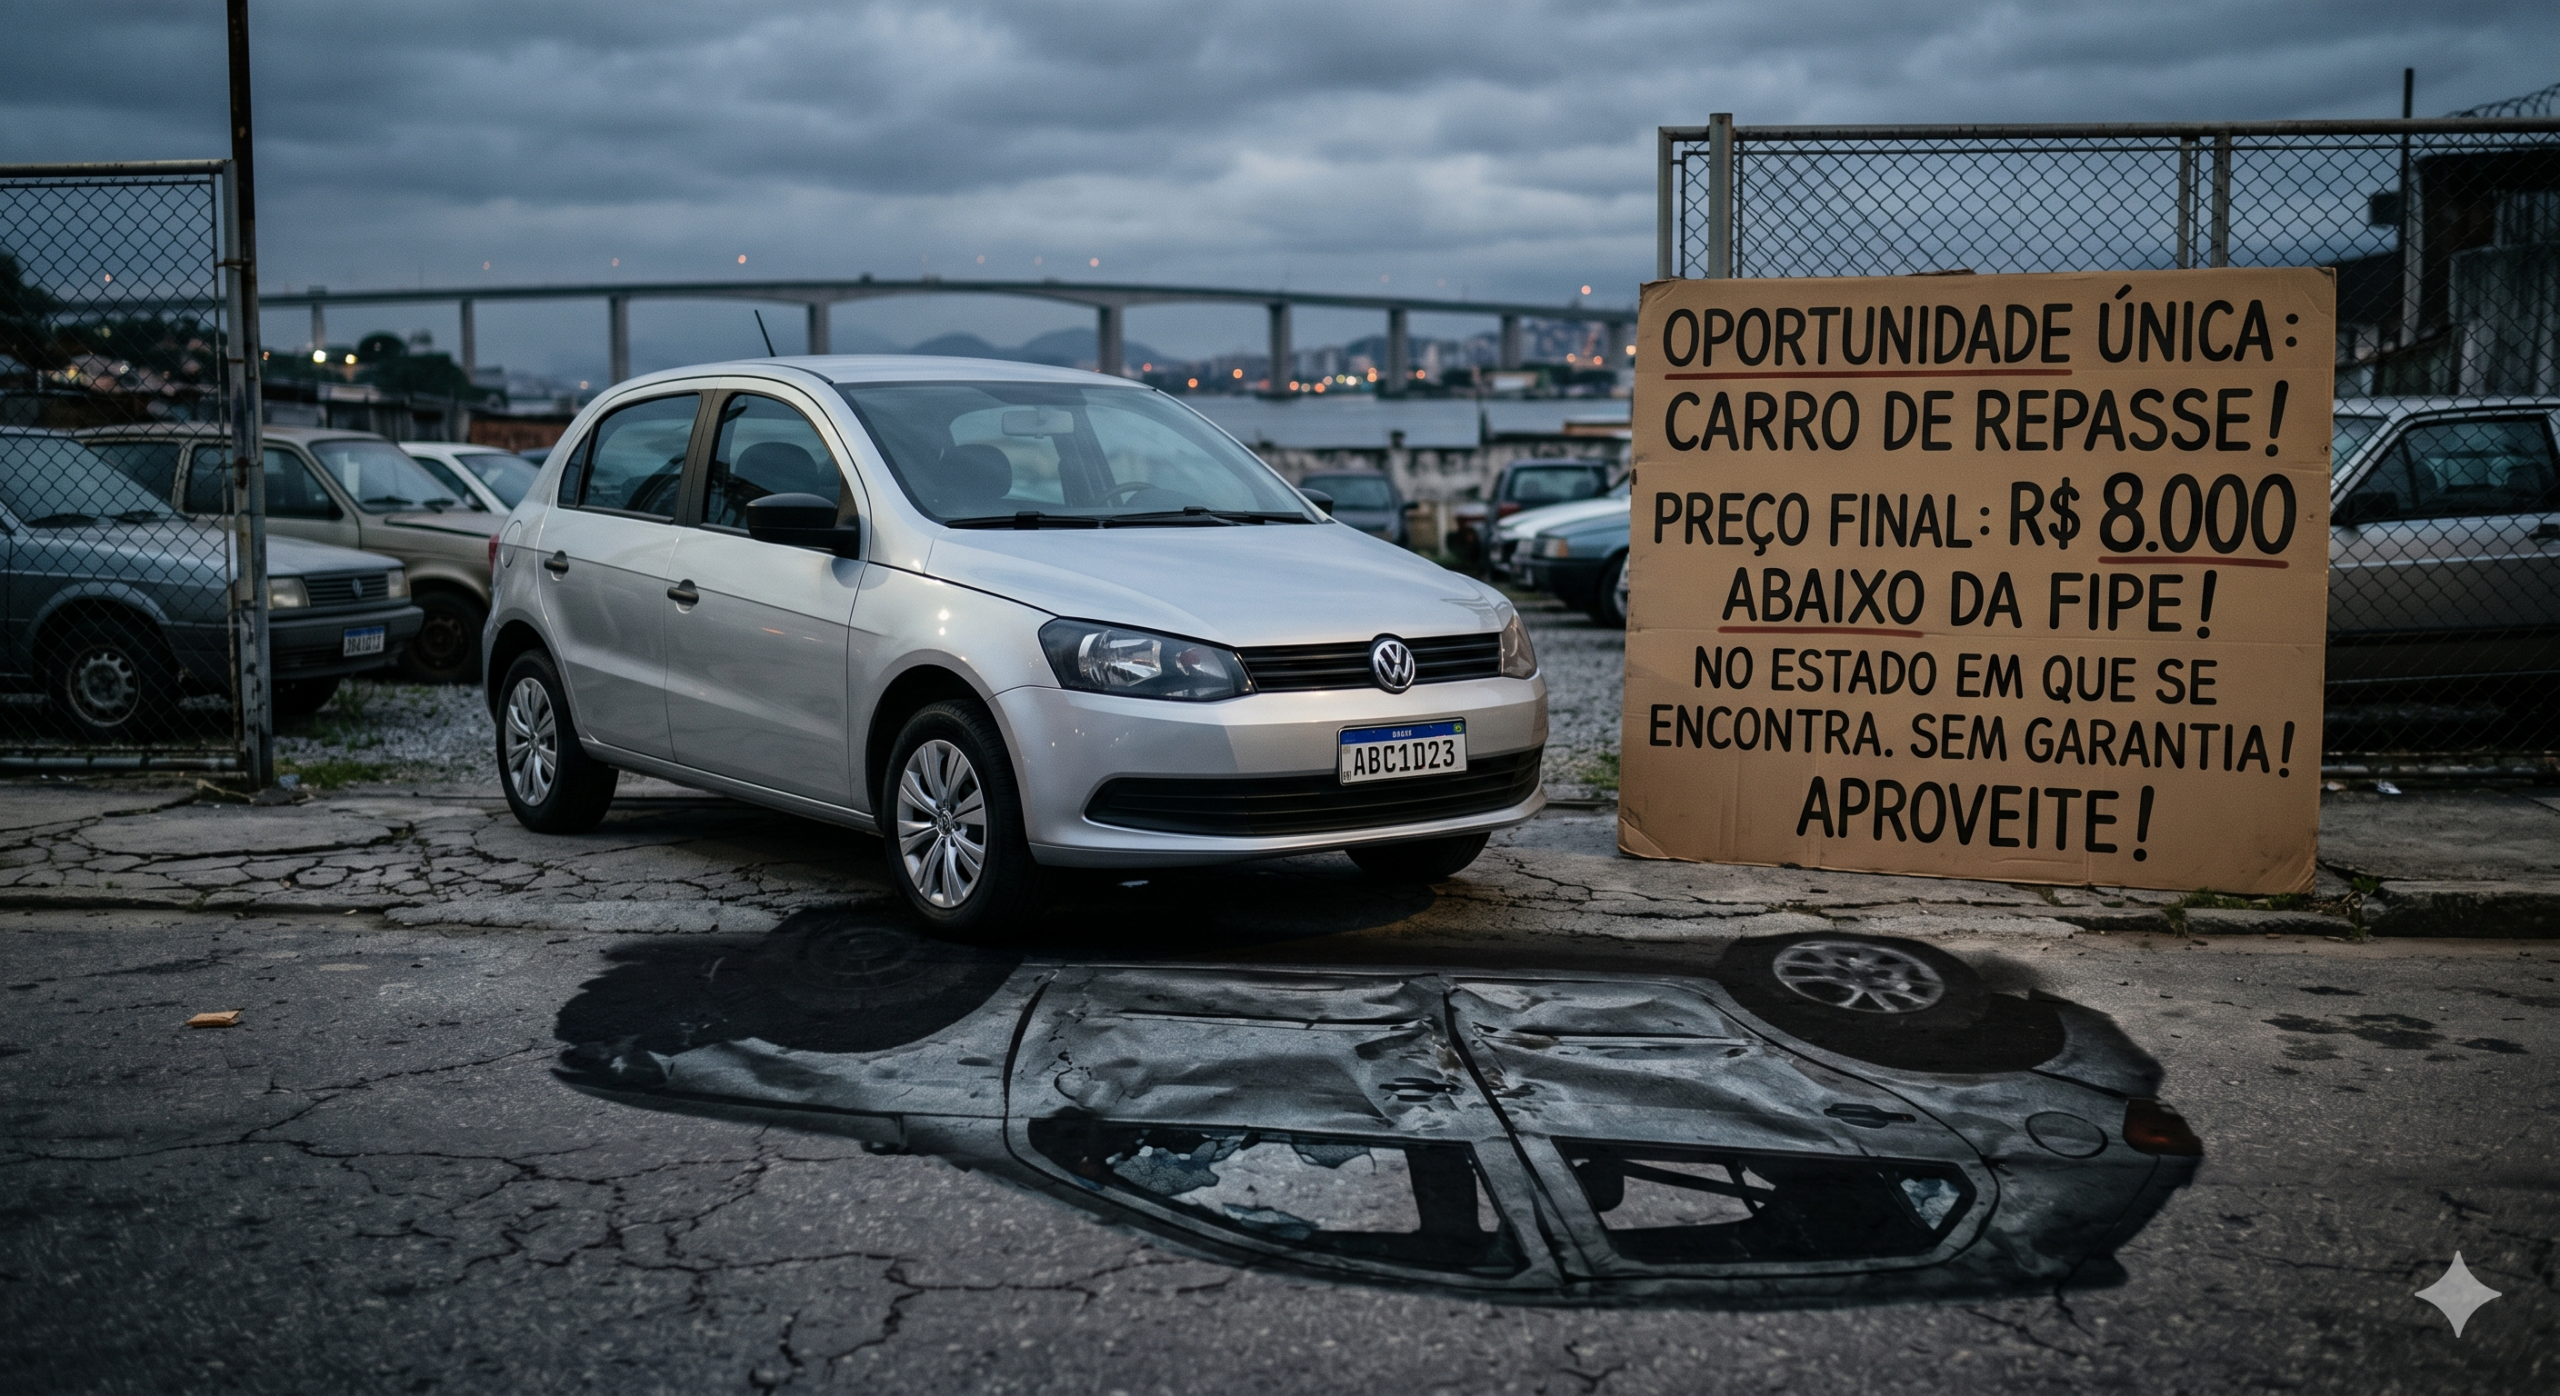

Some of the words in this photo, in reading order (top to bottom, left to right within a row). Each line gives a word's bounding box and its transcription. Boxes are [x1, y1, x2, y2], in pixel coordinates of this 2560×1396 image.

[1662, 303, 2073, 367] OPORTUNIDADE
[2098, 283, 2299, 364] ÚNICA:
[1664, 390, 1860, 452] CARRO
[1883, 390, 1955, 452] DE
[1975, 379, 2290, 458] REPASSE!
[1654, 492, 1810, 558] PREÇO
[1829, 493, 1991, 549] FINAL:
[2009, 476, 2082, 552] R$
[2099, 471, 2297, 556] 8.000
[1722, 566, 1925, 627] ABAIXO
[1950, 570, 2023, 629] DA
[2049, 569, 2218, 640] FIPE!
[1694, 645, 1754, 691] NO
[1771, 647, 1937, 697] ESTADO
[1956, 653, 2024, 700] EM
[2042, 654, 2137, 705] QUE
[2155, 658, 2218, 707] SE
[1353, 739, 1455, 777] ABC1D23
[1649, 703, 1894, 758] ENCONTRA.
[1910, 712, 2008, 763] SEM
[2024, 720, 2296, 779] GARANTIA!
[1795, 775, 2156, 863] APROVEITE!
